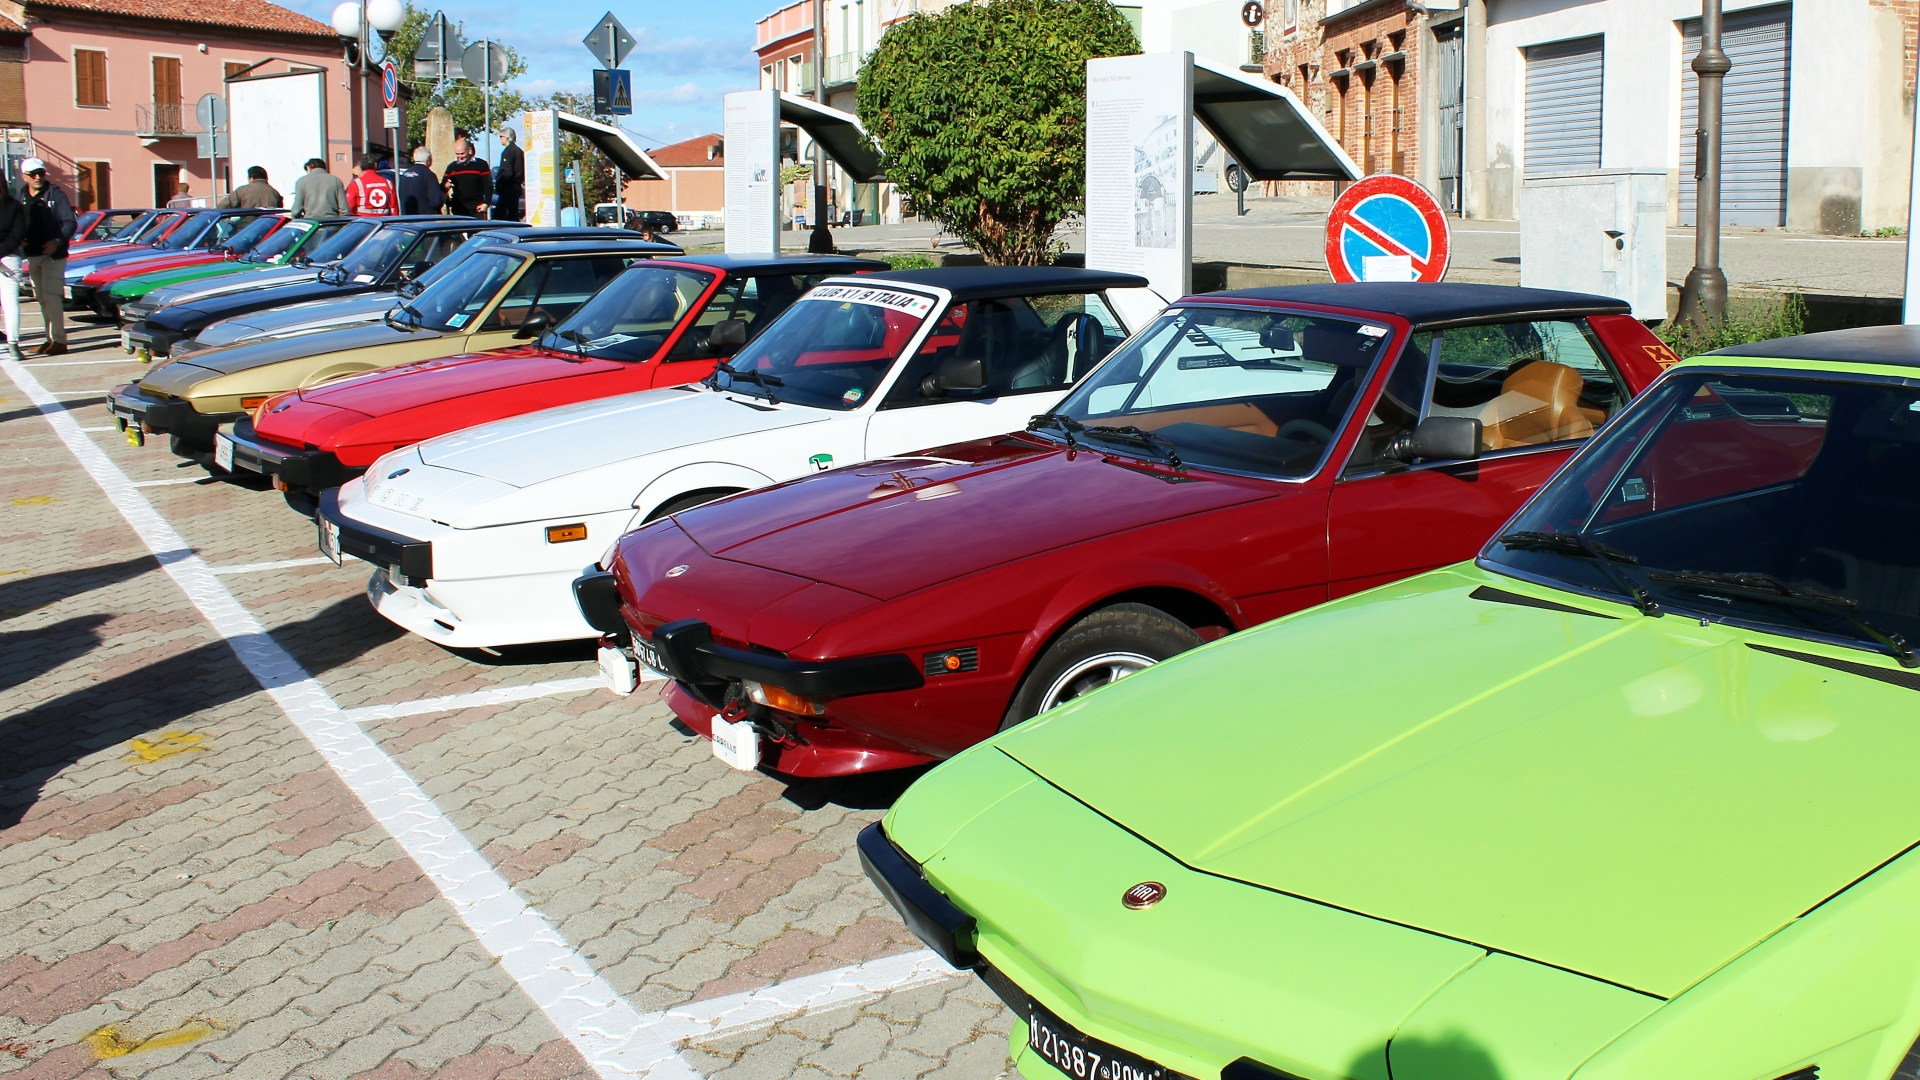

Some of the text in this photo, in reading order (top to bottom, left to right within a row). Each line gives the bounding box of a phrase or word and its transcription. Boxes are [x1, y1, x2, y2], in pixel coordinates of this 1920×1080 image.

[813, 287, 842, 297] CLUB
[872, 292, 915, 308] ITALIA
[1129, 884, 1159, 901] FIAT
